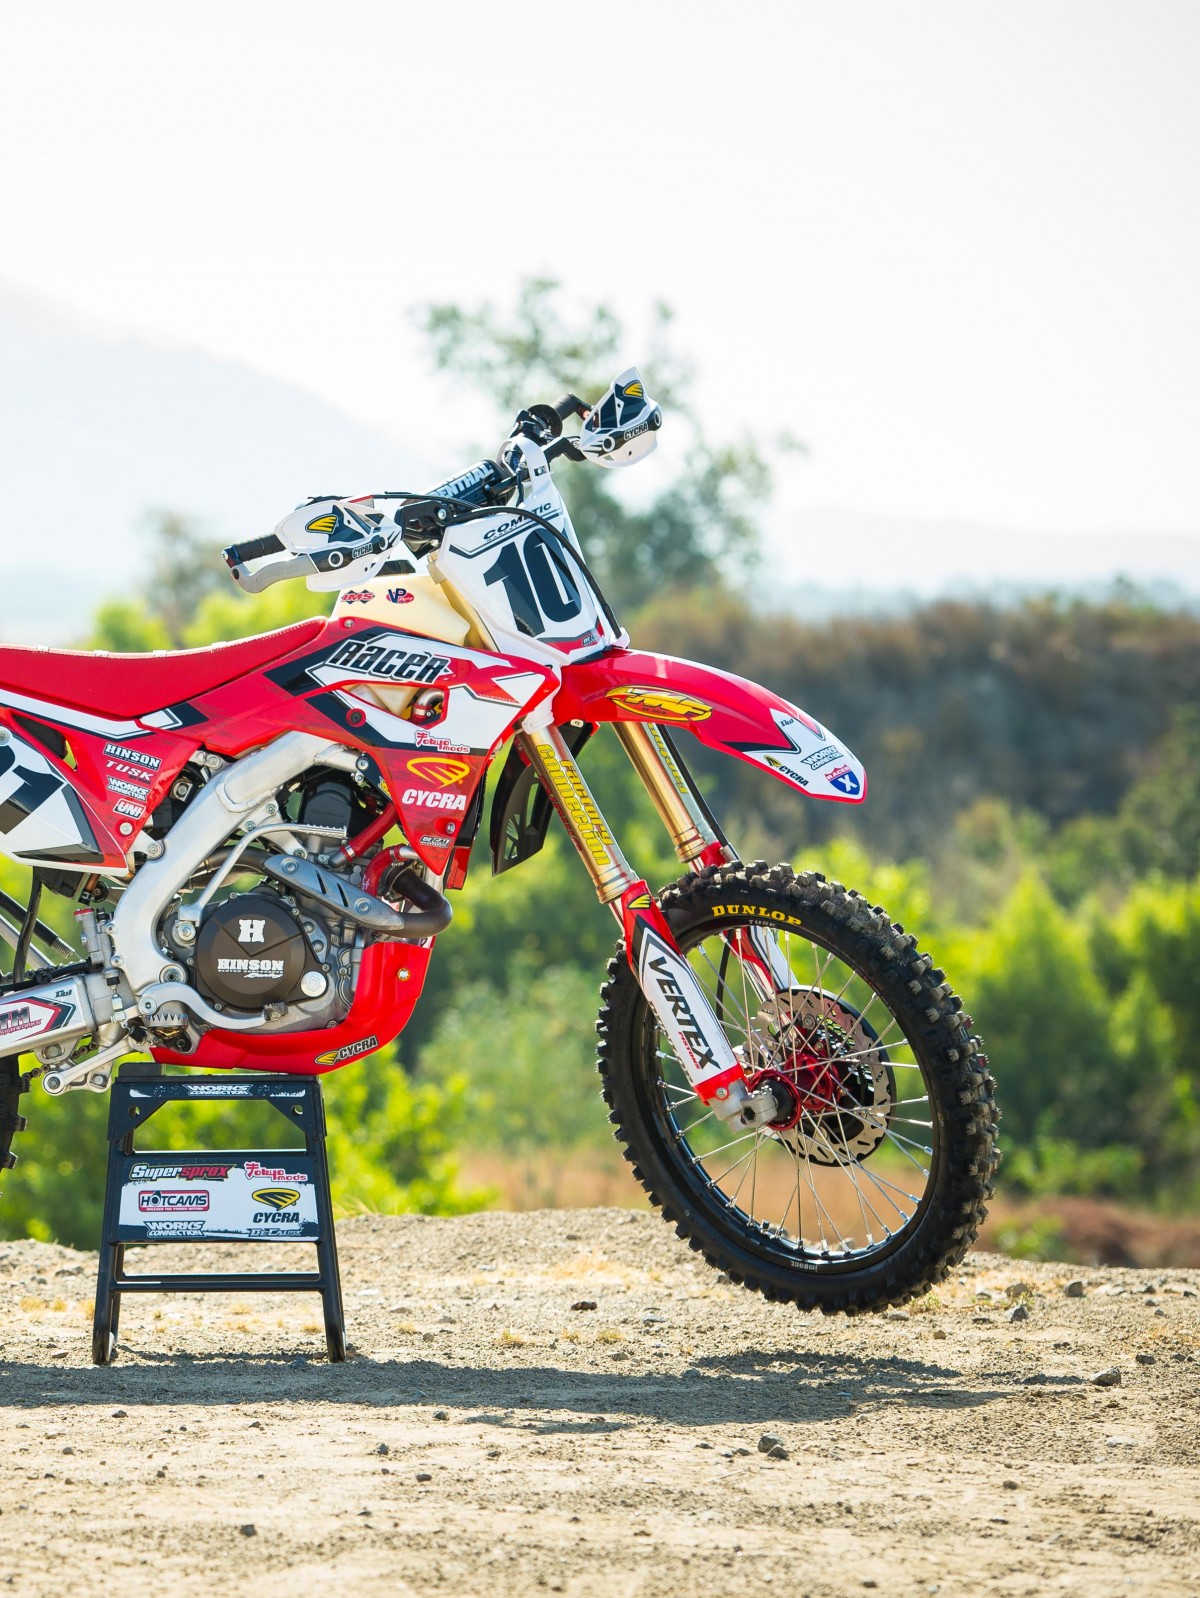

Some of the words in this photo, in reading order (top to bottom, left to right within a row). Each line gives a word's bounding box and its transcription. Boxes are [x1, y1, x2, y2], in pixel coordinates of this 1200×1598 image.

[623, 421, 648, 441] CYCRA
[483, 502, 552, 540] COMTIC
[352, 543, 374, 559] CYCRA
[341, 592, 375, 602] IMS
[388, 588, 407, 604] VP
[105, 743, 160, 768] HINSON
[803, 746, 838, 764] WORKS
[106, 760, 155, 781] TUSK
[779, 765, 809, 787] CYCRA
[827, 766, 851, 780] RACER
[108, 777, 149, 796] WORKS
[837, 774, 858, 792] X
[117, 801, 143, 817] UNI
[402, 789, 467, 811] CYCRA
[711, 904, 802, 926] DUNLOP
[238, 919, 266, 943] H
[217, 958, 285, 971] HINSON
[648, 956, 722, 1070] VERTEX
[339, 1035, 378, 1060] CYCRA
[678, 1031, 701, 1070] PISTONS
[141, 1194, 207, 1206] HOTCAMS
[146, 1221, 204, 1230] WORKS
[253, 1212, 300, 1224] CYCRA
[148, 1229, 203, 1237] CONNECTION
